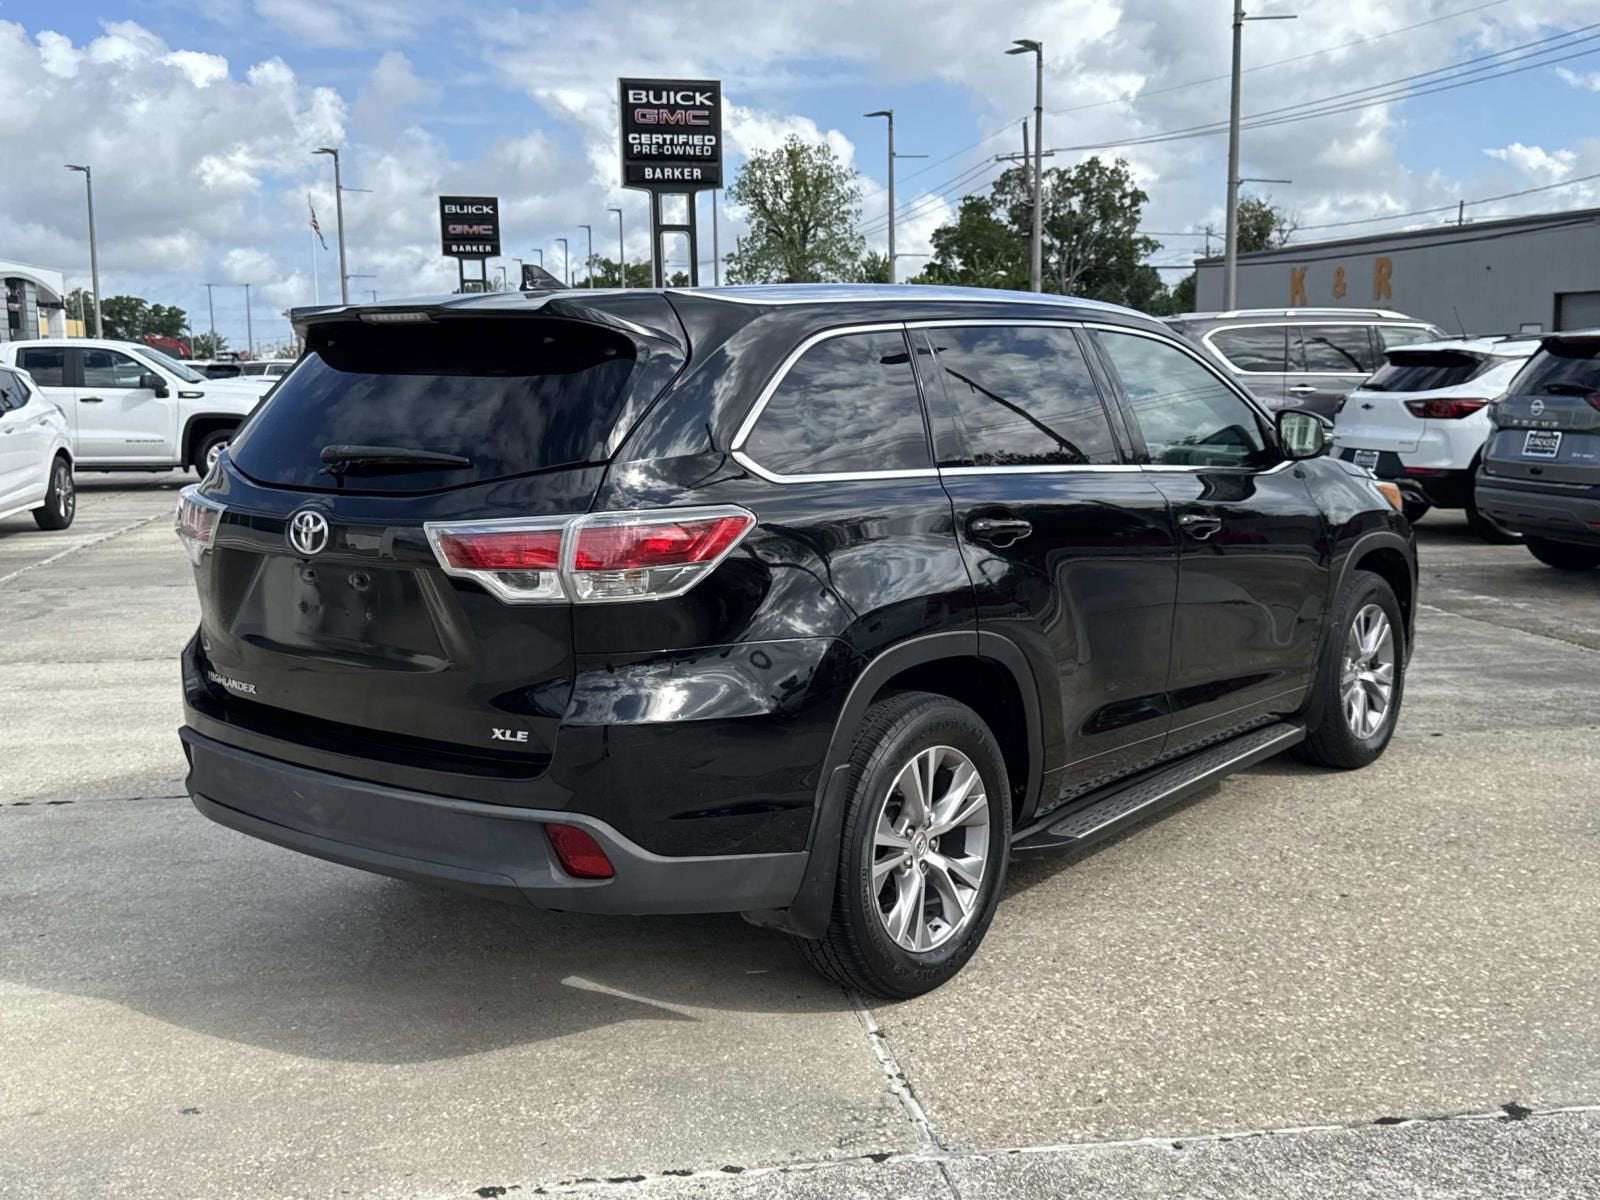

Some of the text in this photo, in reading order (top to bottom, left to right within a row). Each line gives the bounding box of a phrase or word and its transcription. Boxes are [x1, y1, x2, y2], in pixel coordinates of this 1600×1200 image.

[628, 89, 714, 106] BUICK
[634, 108, 710, 126] GMC
[628, 133, 716, 146] CERTIFIED
[633, 144, 712, 156] PRE-OWNED
[644, 167, 702, 180] BARKER
[444, 204, 494, 214] BUICK
[448, 224, 493, 235] GMC
[451, 244, 492, 252] BARKER
[1288, 255, 1393, 307] K & R
[207, 671, 257, 694] HIGHLANDER
[491, 728, 529, 743] XLE
